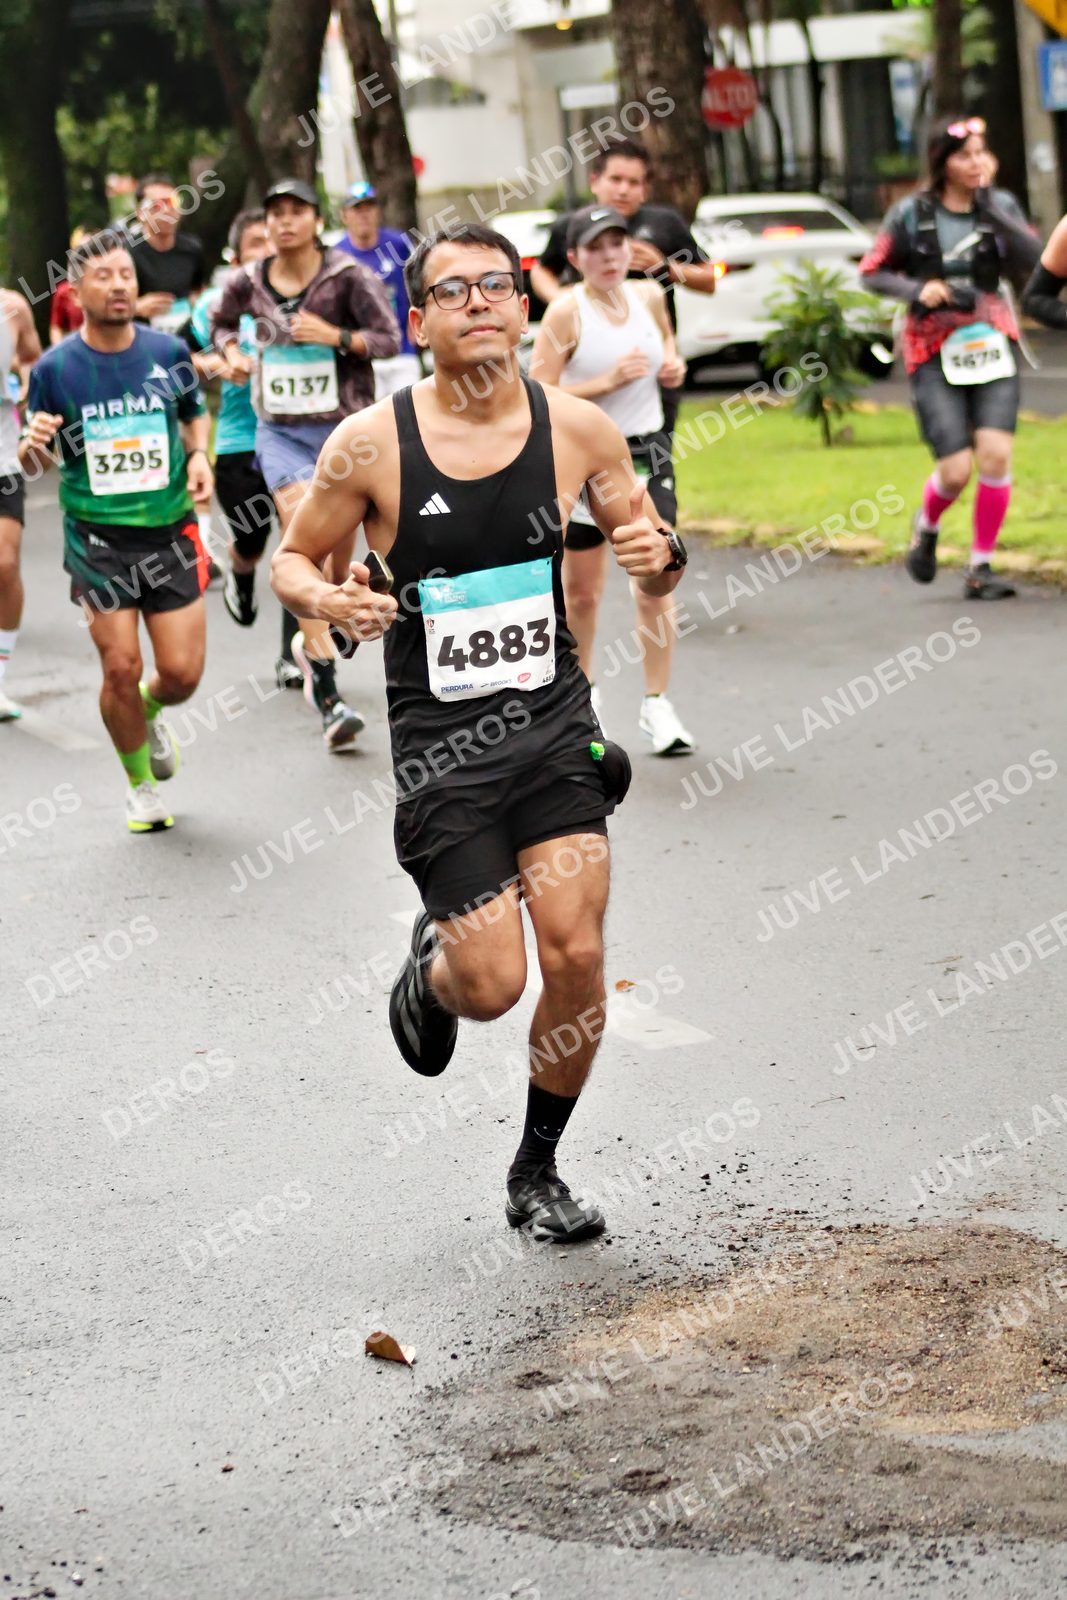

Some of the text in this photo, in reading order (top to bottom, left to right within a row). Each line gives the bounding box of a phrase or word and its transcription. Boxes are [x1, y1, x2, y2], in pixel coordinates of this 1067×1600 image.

[701, 84, 756, 111] ALTO
[270, 375, 330, 396] 6137
[81, 394, 165, 423] PIRMA
[94, 449, 163, 475] 3295
[437, 617, 551, 672] 4883
[441, 683, 474, 693] PERDURA
